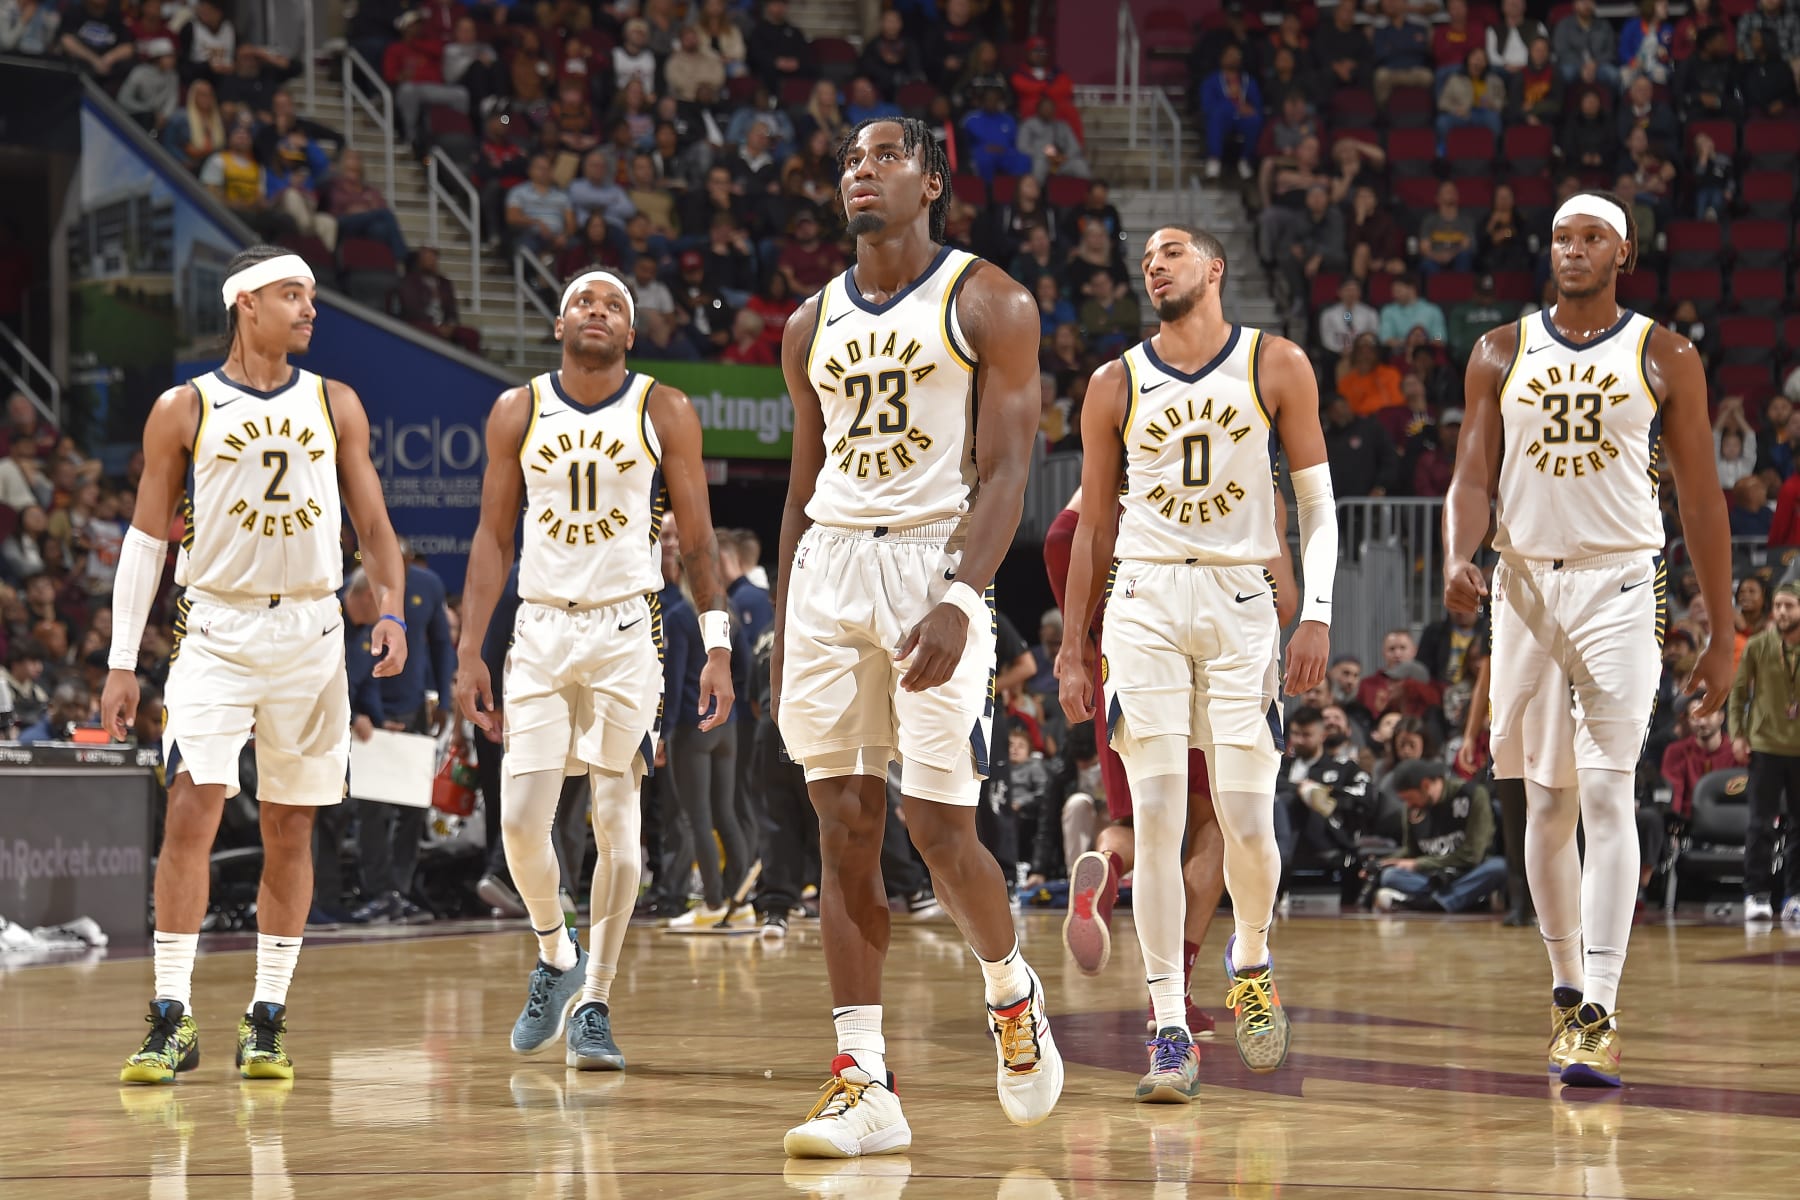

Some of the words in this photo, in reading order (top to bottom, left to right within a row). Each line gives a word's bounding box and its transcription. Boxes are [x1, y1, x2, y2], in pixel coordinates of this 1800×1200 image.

[818, 330, 938, 396] INDIANA
[1517, 363, 1630, 408] INDIANA
[844, 368, 909, 441] 23
[1139, 397, 1252, 455] INDIANA
[1542, 393, 1603, 444] 33
[216, 415, 326, 463] INDIANA
[530, 429, 637, 475] INDIANA
[831, 426, 934, 480] PACERS
[1182, 434, 1211, 488] 0
[1526, 440, 1621, 478] PACERS
[262, 449, 291, 502] 2
[567, 460, 597, 513] 11
[228, 497, 324, 537] PACERS
[537, 507, 629, 546] PACERS
[1146, 480, 1246, 525] PACERS
